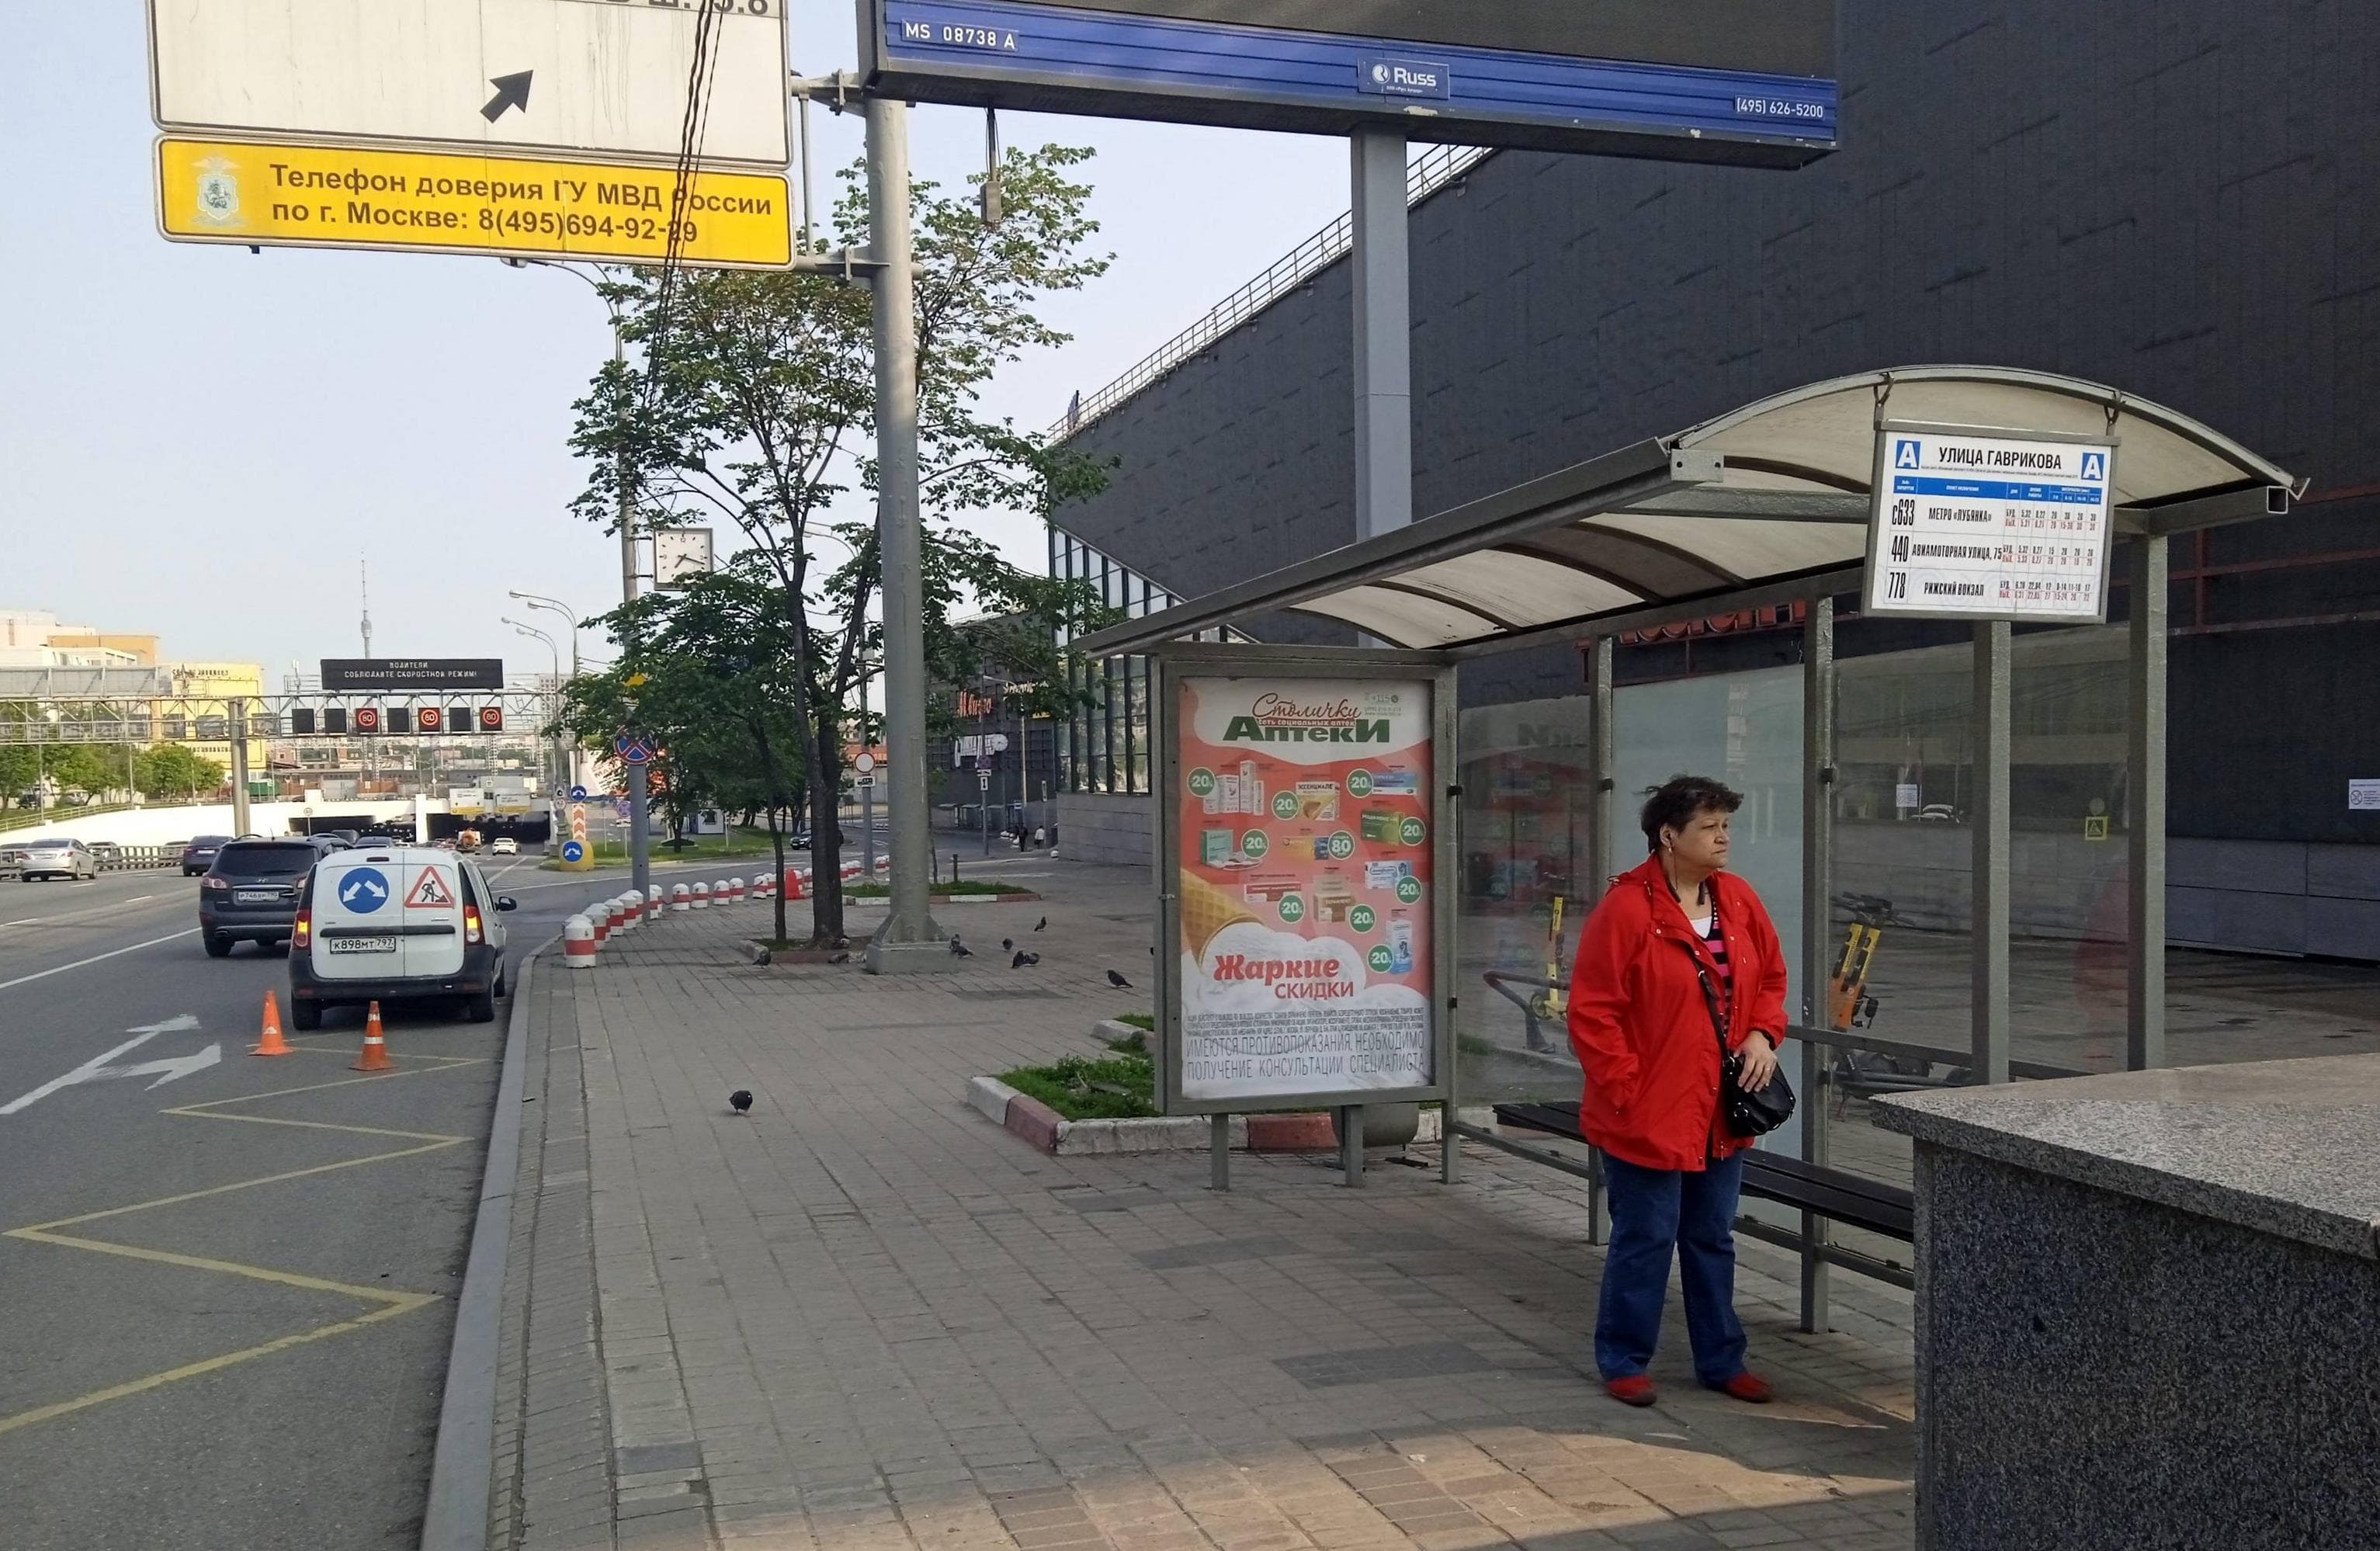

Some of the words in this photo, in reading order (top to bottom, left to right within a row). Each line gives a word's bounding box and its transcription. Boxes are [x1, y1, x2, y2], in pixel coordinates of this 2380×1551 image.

[905, 22, 931, 39] MS
[942, 26, 996, 46] 08738
[1004, 33, 1015, 49] A
[1393, 67, 1436, 87] Russ
[1736, 97, 1766, 114] (495)
[1769, 102, 1823, 118] 626-5200
[270, 164, 406, 195] Телефон
[415, 177, 543, 203] доверия
[554, 179, 587, 203] ГУ
[597, 182, 662, 211] МВД
[272, 203, 309, 221] по
[320, 205, 336, 223] г.
[347, 201, 467, 229] Москве:
[1899, 442, 1917, 468] А
[1939, 447, 1983, 465] УЛИЦА
[1987, 450, 2062, 470] ГАВРИКОВА
[2083, 454, 2101, 479] А
[1929, 508, 1952, 521] МЕТРО
[1891, 535, 1909, 562] 440
[1911, 543, 1966, 558] АВИАМОТОРНАЯ
[1968, 546, 1992, 560] УЛИЦА,
[1993, 547, 2002, 560] 75
[1888, 571, 1906, 599] 778
[1924, 581, 1957, 595] РИЖСКИЙ
[1958, 583, 1984, 596] ВОКЗАЛ
[1252, 692, 1362, 719] Столички
[1213, 954, 1340, 986] Жаркие
[1187, 1037, 1239, 1057] ИМЕЮТСЯ
[1355, 1031, 1424, 1050] НЕОБХОДИМО
[1187, 1060, 1253, 1080] ПОЛУЧЕНИЕ
[1259, 1056, 1344, 1077] КОНСУЛЬТАЦИИ
[1349, 1052, 1425, 1074] СПЕЦИАЛИСТА
